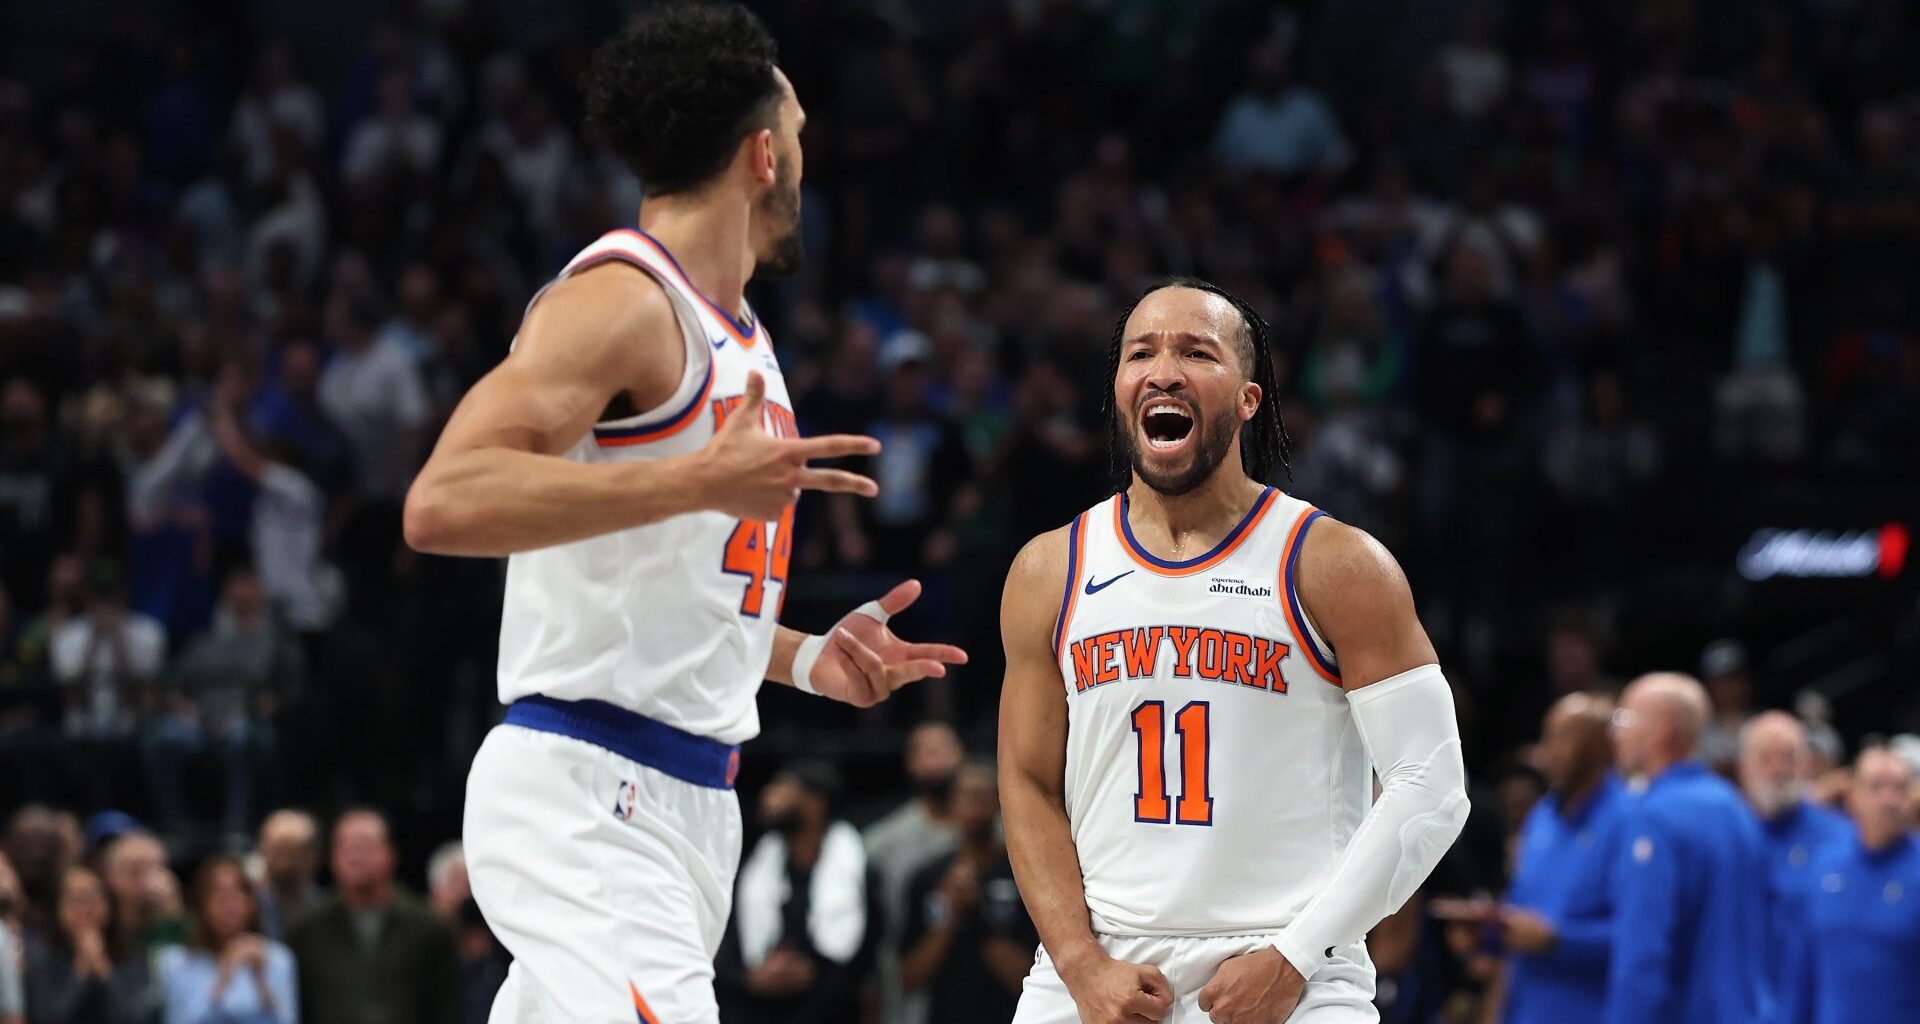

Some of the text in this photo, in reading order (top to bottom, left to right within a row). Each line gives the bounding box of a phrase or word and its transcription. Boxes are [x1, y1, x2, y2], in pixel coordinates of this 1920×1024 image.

[721, 501, 796, 622] 44
[1209, 583, 1271, 596] abu dhabi
[1070, 625, 1292, 696] NEW YORK
[1130, 700, 1214, 826] 11
